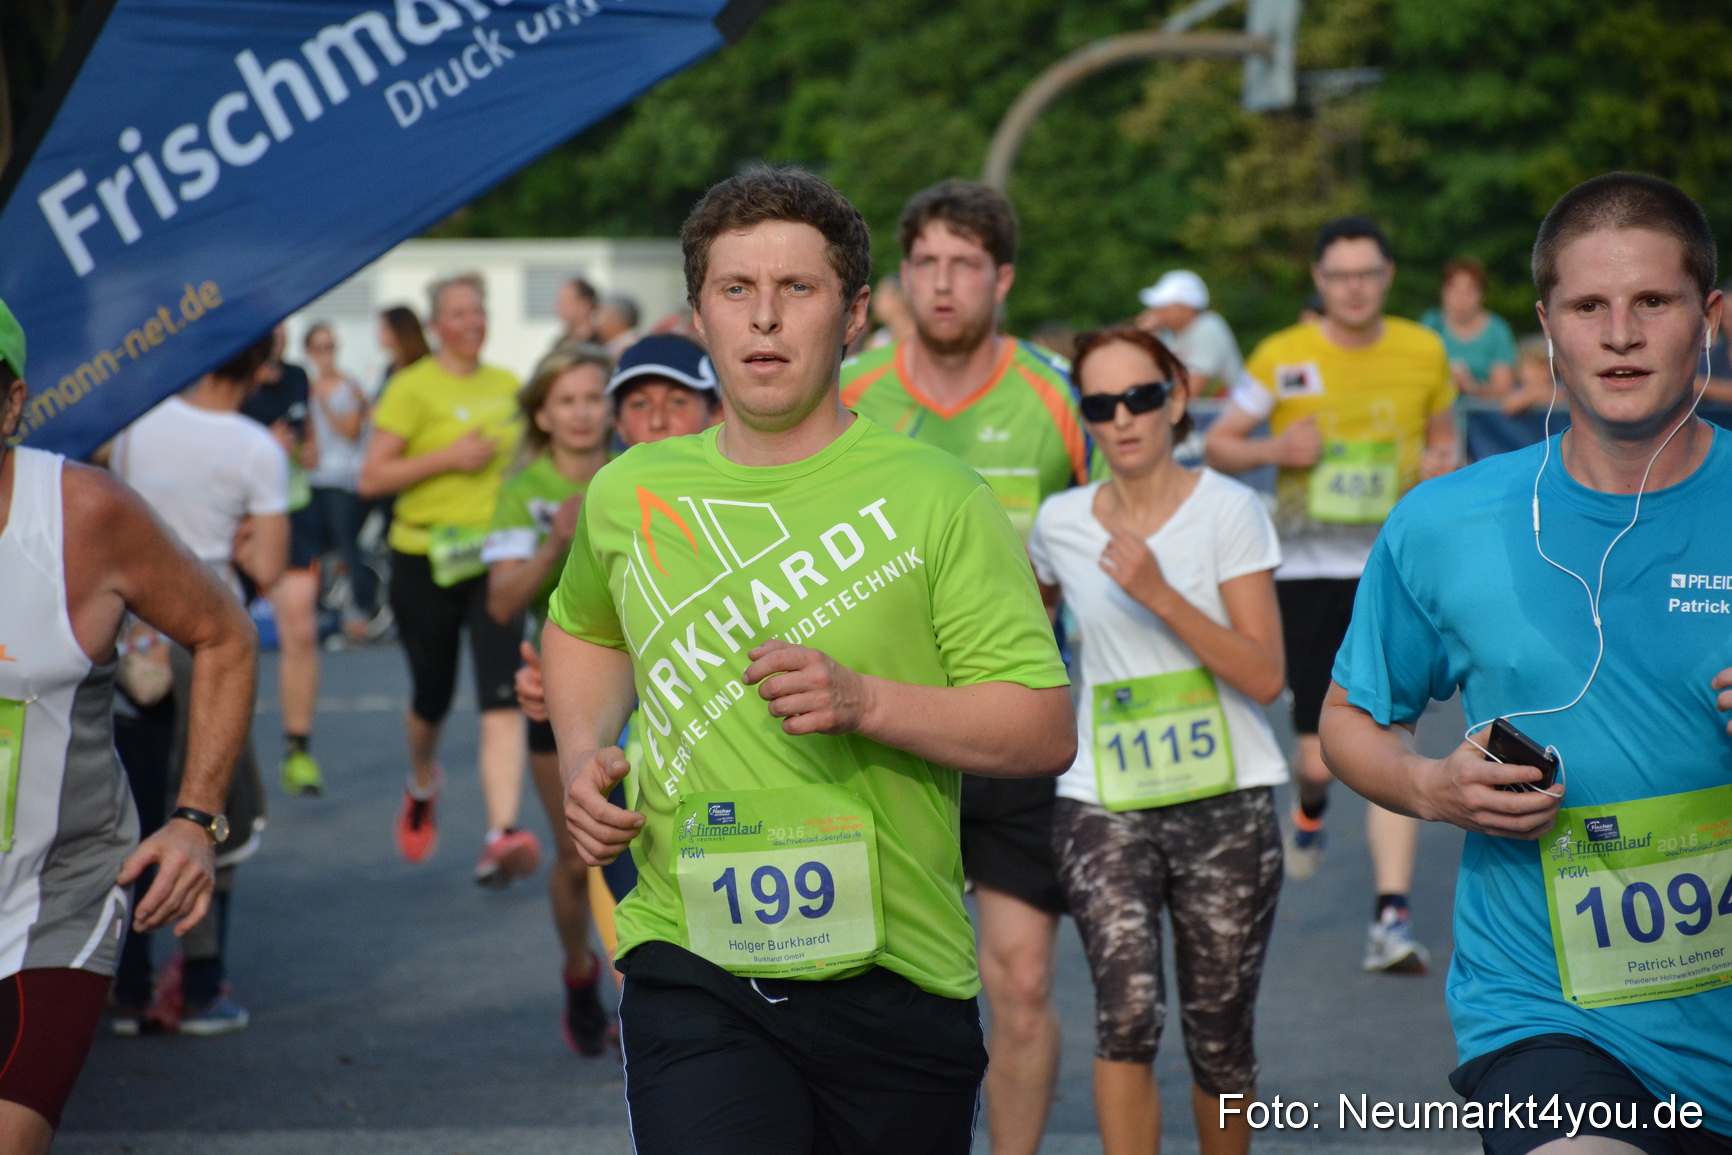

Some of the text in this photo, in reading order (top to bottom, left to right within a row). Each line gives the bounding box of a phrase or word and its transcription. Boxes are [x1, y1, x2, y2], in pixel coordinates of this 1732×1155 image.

[383, 25, 516, 129] Druck
[38, 0, 513, 277] Frischma
[772, 546, 925, 645] UDETECHNIK
[1668, 598, 1731, 614] Patrick
[1107, 719, 1216, 773] 1115
[696, 821, 764, 837] firmenlauf
[766, 826, 805, 842] 2016
[1576, 832, 1652, 854] firmenlauf
[1657, 833, 1698, 853] 2016
[712, 861, 836, 926] 199
[728, 932, 831, 953] Holger Burkhardt
[753, 952, 805, 963] Burkhardt GmbH
[1627, 947, 1725, 974] Patrick Lehner
[1624, 976, 1658, 987] Pfleiderer
[1659, 967, 1711, 982] Holzwerkstoffe
